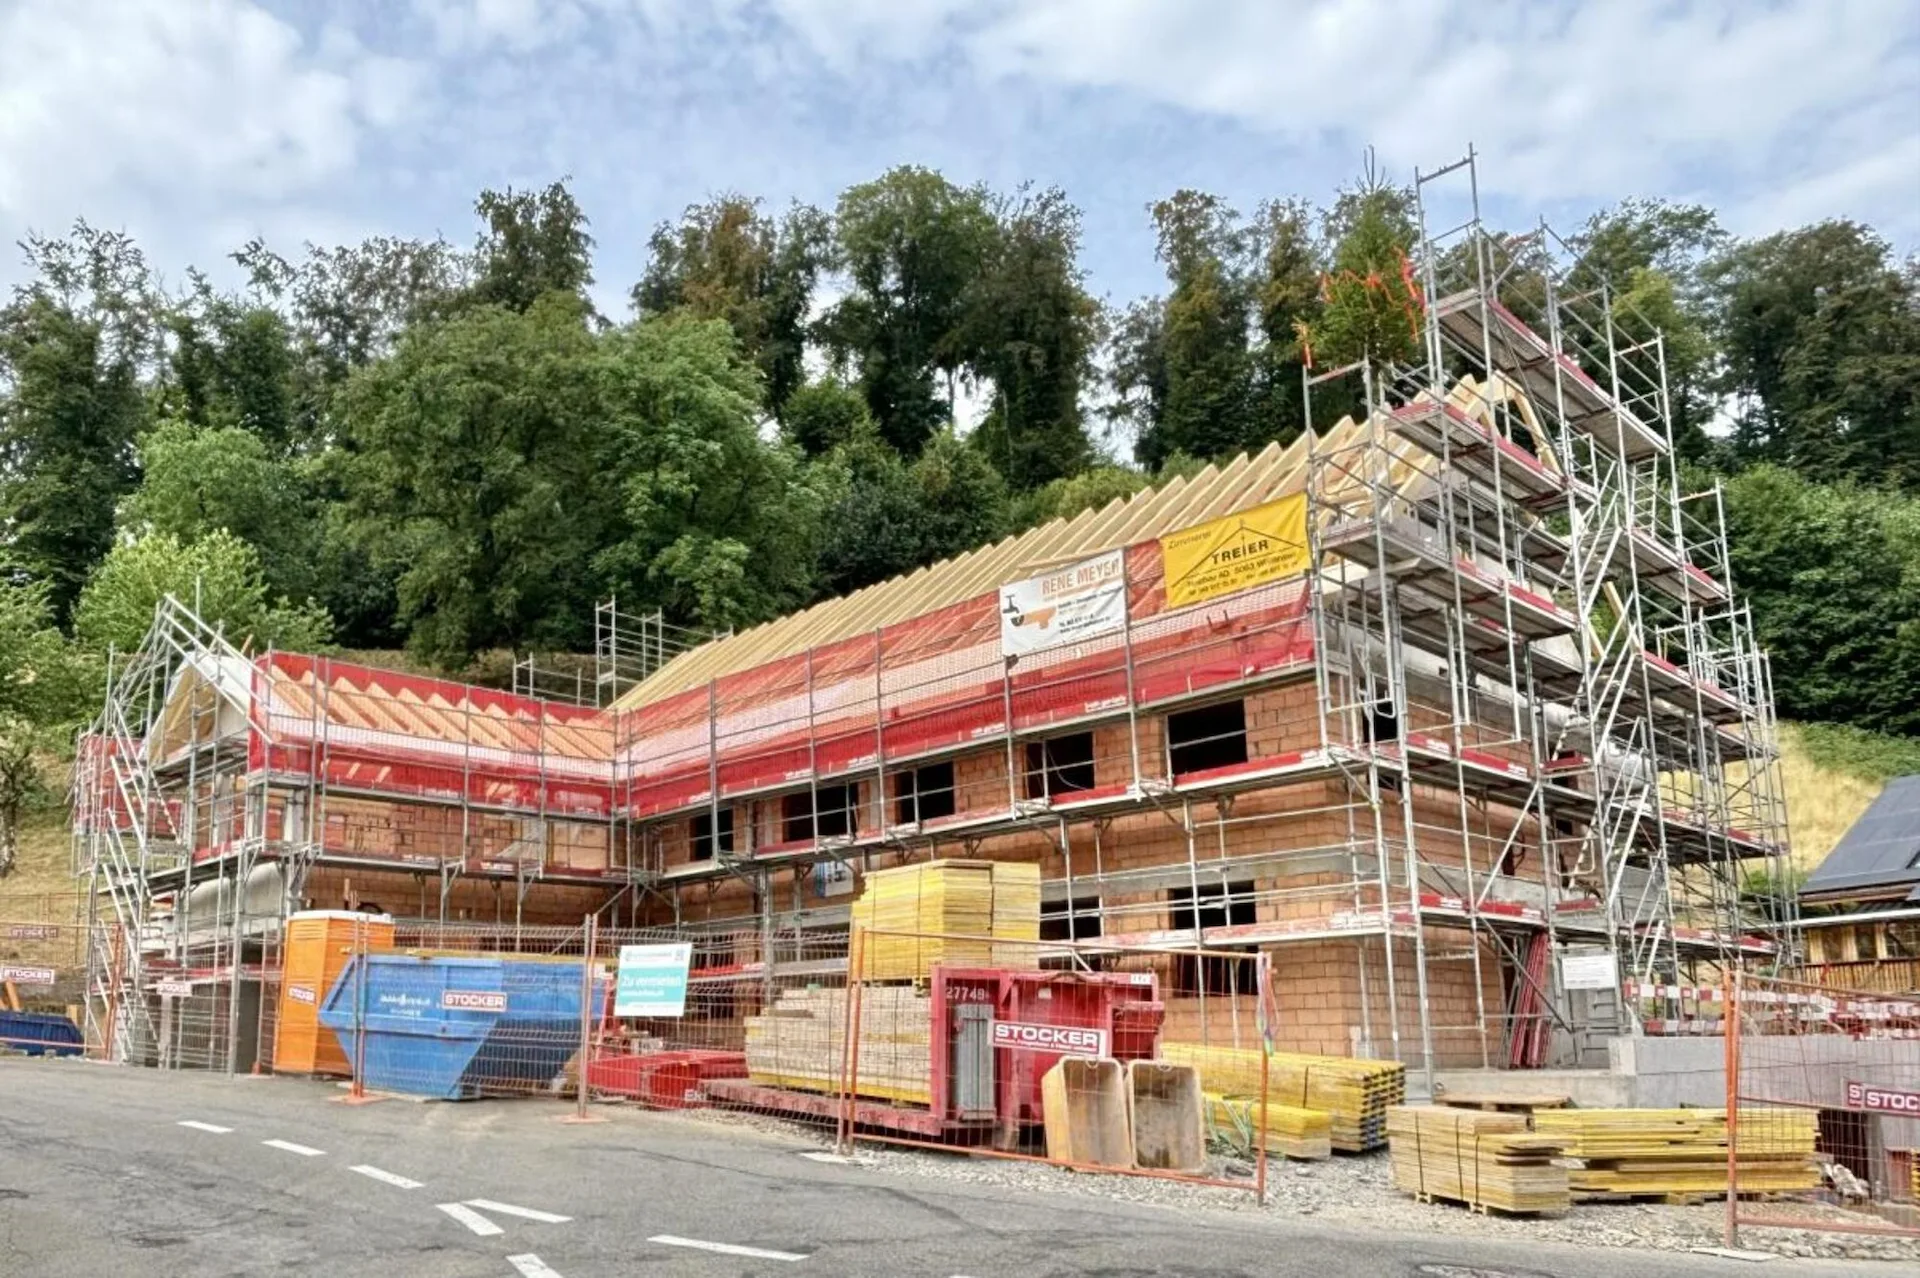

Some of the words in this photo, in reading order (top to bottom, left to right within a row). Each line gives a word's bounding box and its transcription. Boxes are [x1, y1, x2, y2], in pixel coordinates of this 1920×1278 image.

[1211, 539, 1269, 565] TREIER
[1076, 558, 1119, 584] MEYER
[4, 968, 50, 980] STOCKER
[445, 993, 505, 1007] STOCKER
[995, 1024, 1098, 1048] STOCKER
